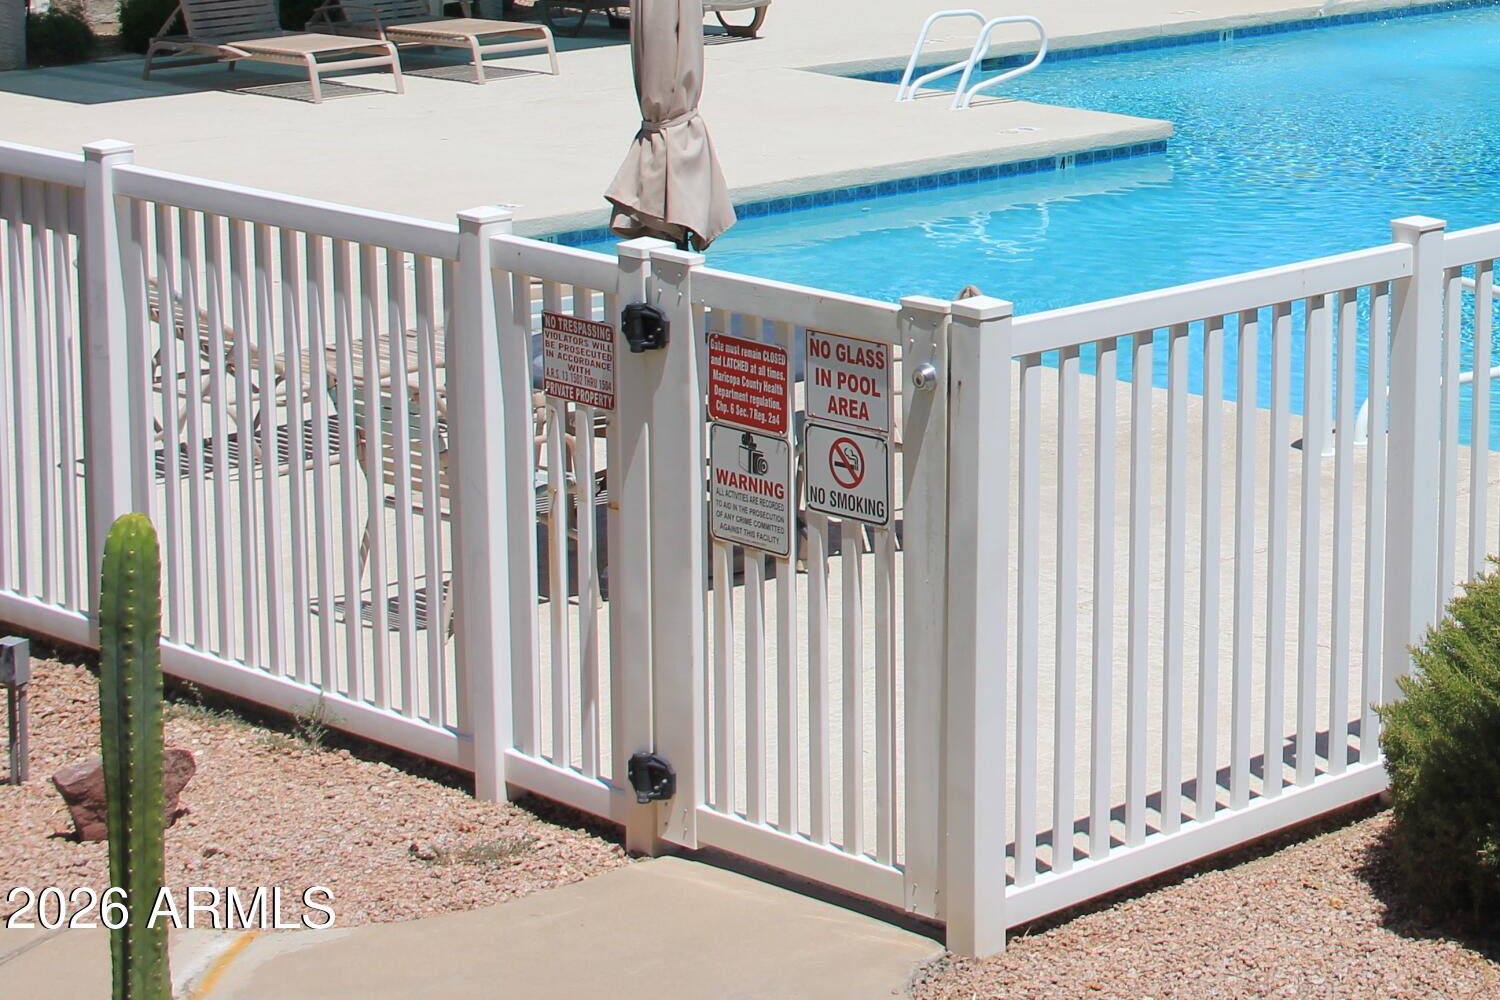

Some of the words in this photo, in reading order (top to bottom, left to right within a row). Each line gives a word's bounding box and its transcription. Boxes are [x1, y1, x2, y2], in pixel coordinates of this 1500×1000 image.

[545, 315, 556, 329] NO
[557, 317, 611, 340] TRESPASSING
[545, 331, 589, 346] VIOLATORS
[592, 341, 611, 352] WILL
[545, 340, 556, 348] BE
[559, 343, 612, 362] PROSECUTED
[710, 338, 724, 352] Gate
[725, 344, 740, 355] must
[741, 347, 762, 360] remain
[762, 350, 786, 365] CLOSED
[810, 338, 831, 359] NO
[836, 343, 885, 370] GLASS
[546, 350, 554, 358] IN
[557, 352, 611, 371] ACCORDANCE
[568, 364, 590, 375] WITH
[711, 356, 721, 366] and
[723, 356, 748, 372] LATCHED
[750, 364, 757, 374] at
[758, 365, 766, 376] all
[767, 367, 785, 381] times.
[546, 381, 575, 399] PRIVATE
[575, 388, 613, 407] PROPERTY
[713, 369, 740, 387] Maricopa
[741, 376, 762, 392] County
[763, 381, 783, 395] Health
[815, 367, 832, 387] IN
[837, 372, 881, 398] POOL
[714, 384, 748, 402] Department
[749, 395, 782, 410] regulation.
[827, 395, 869, 421] AREA
[716, 468, 784, 500] WARNING
[716, 488, 725, 497] ALL
[725, 490, 749, 503] ACTIVITIES
[749, 495, 758, 505] ARE
[759, 497, 784, 511] RECORDED
[716, 499, 723, 507] TO
[723, 501, 732, 510] AID
[733, 503, 738, 511] IN
[739, 504, 749, 514] THE
[749, 507, 784, 523] PROSECUTION
[810, 485, 826, 505] NO
[829, 490, 885, 518] SMOKING
[716, 510, 723, 518] OF
[724, 512, 735, 521] ANY
[736, 515, 753, 526] CRIME
[754, 519, 784, 534] COMMITTED
[720, 522, 743, 534] AGAINST
[743, 527, 756, 538] THIS
[756, 530, 780, 545] FACILITY
